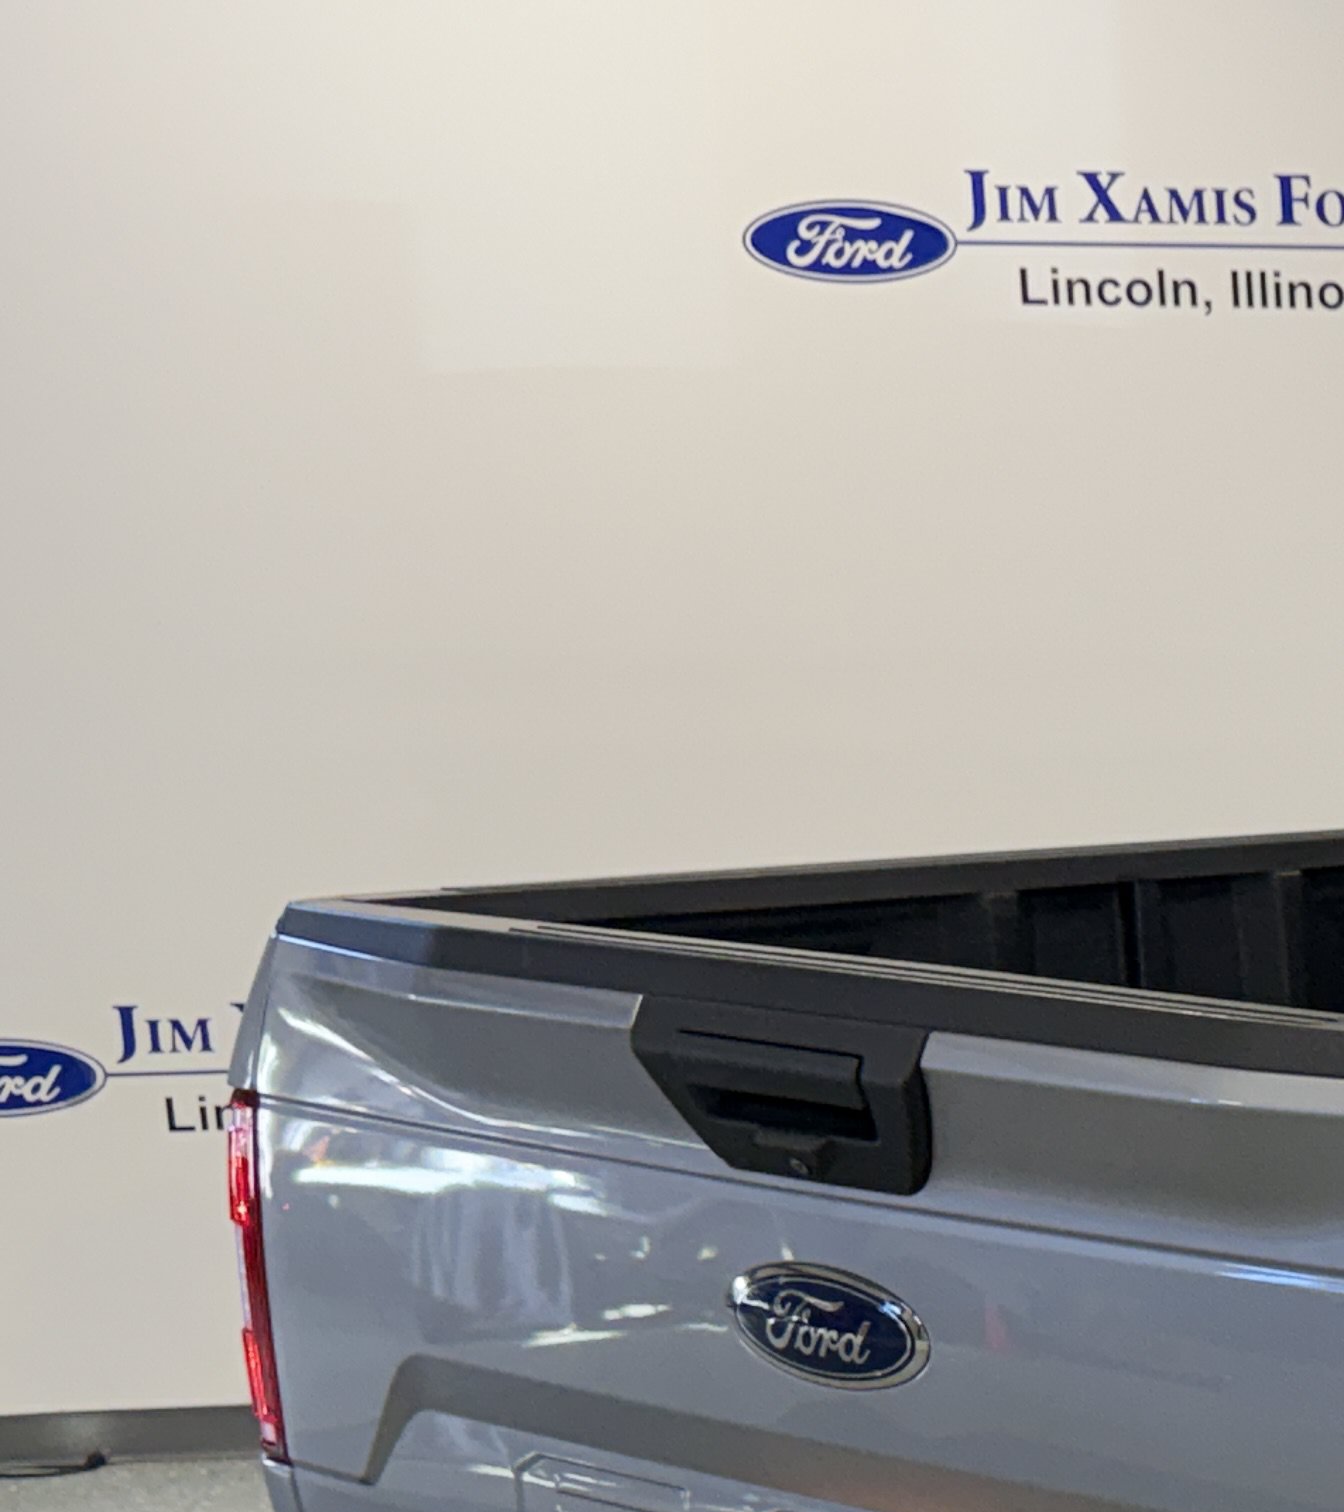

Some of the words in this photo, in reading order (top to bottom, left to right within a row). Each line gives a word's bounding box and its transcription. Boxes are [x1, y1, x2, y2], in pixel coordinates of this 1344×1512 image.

[964, 169, 1059, 231] JIM
[1077, 172, 1256, 226] XAMIS
[786, 214, 914, 269] Ford
[1019, 267, 1212, 315] Lincoln,
[112, 1005, 215, 1063] JIM
[766, 1289, 870, 1365] Ford
